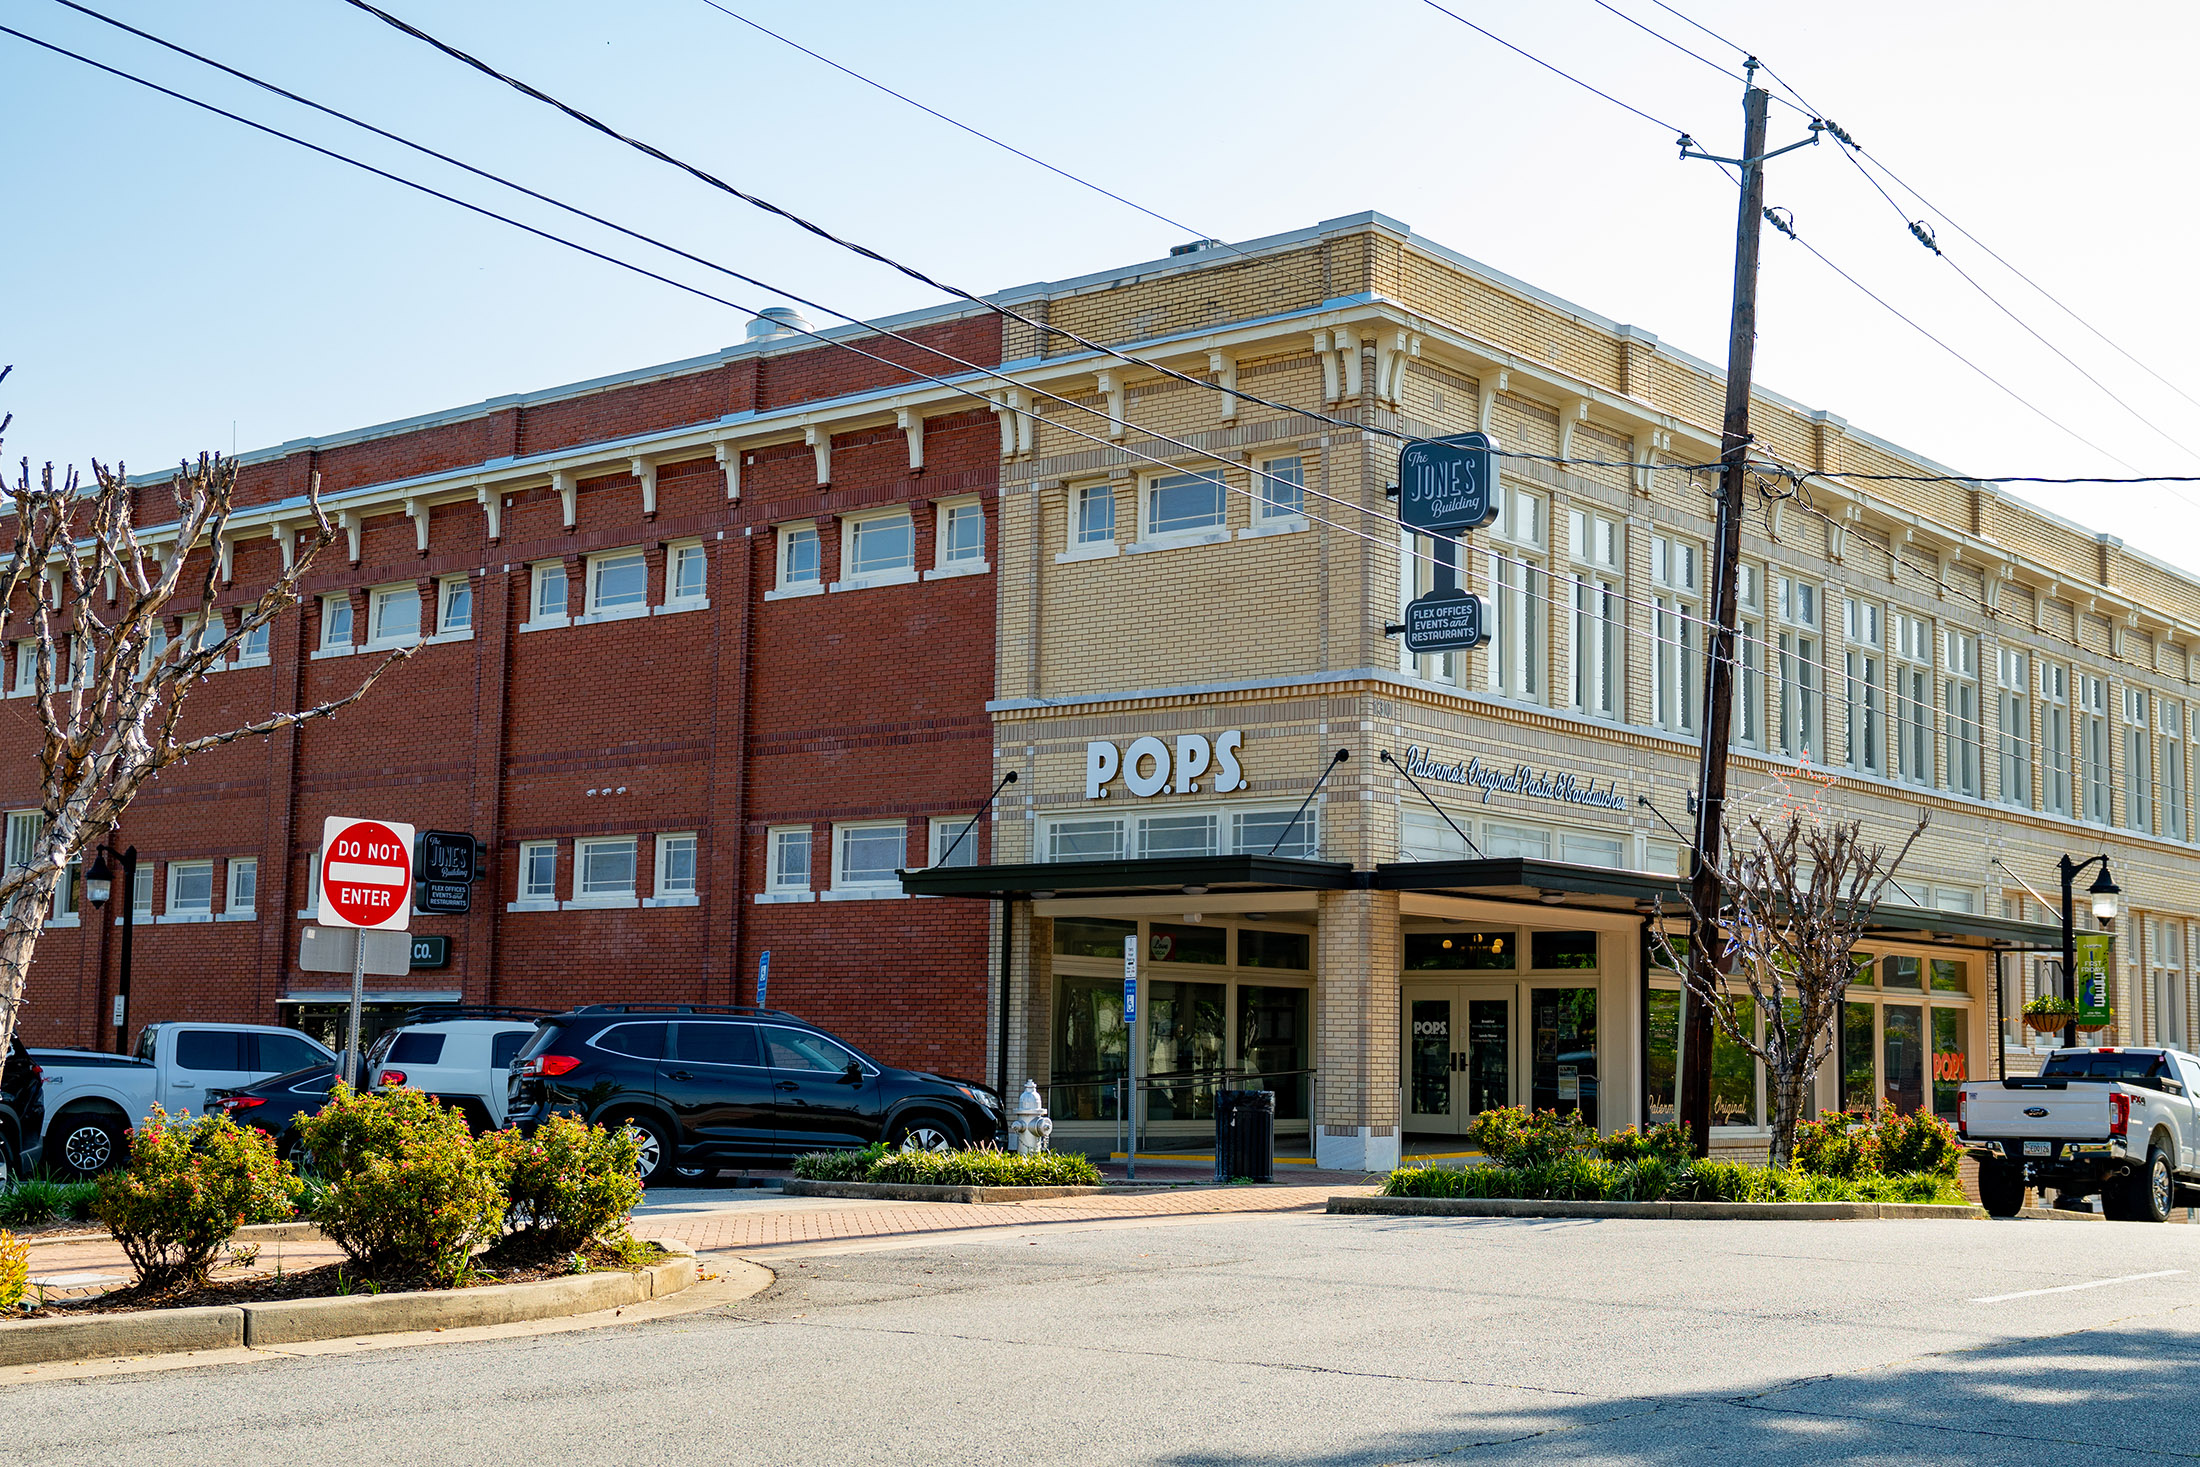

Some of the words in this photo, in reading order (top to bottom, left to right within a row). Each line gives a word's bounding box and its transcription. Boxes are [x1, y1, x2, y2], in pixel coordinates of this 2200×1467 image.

[1407, 451, 1429, 467] The
[1410, 458, 1476, 502] JONES
[1431, 496, 1480, 518] Building
[1413, 608, 1435, 620] FLEX
[1436, 605, 1473, 618] OFFICES
[1415, 618, 1449, 630] EVENTS
[1449, 615, 1469, 627] and
[1411, 626, 1475, 642] RESTAURANTS
[1406, 744, 1467, 783] Palermo's
[1467, 756, 1520, 804] Original
[1520, 766, 1554, 799] Pasta
[338, 840, 361, 858] DO
[368, 843, 400, 861] NOT
[431, 846, 467, 868] JONES
[341, 888, 390, 907] ENTER
[445, 885, 466, 893] OFFICES
[414, 943, 432, 959] CO.
[1648, 1094, 1675, 1114] Palerm
[1714, 1094, 1747, 1124] Original
